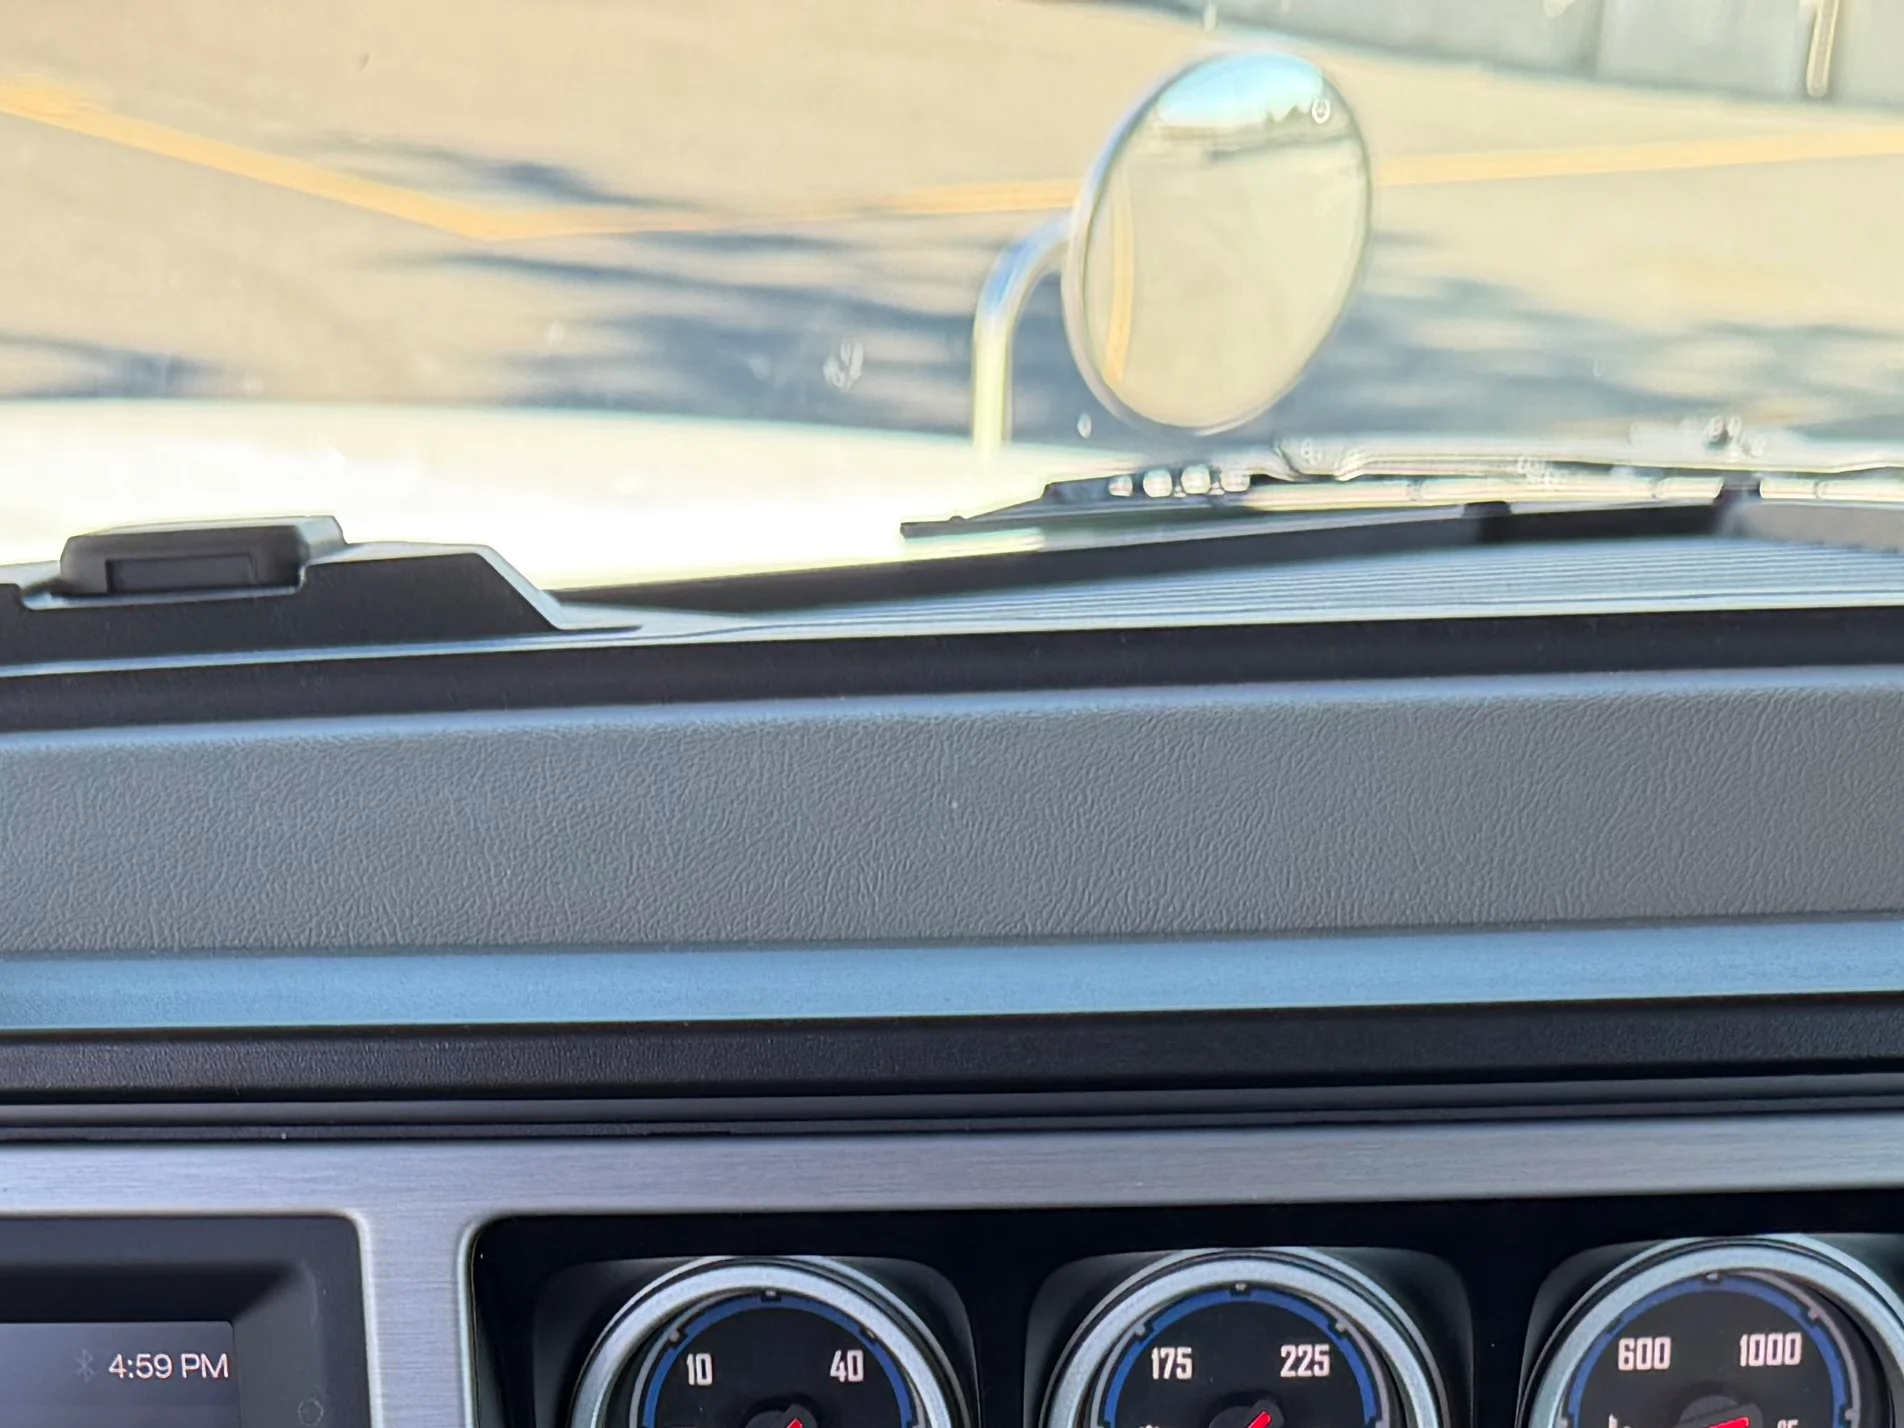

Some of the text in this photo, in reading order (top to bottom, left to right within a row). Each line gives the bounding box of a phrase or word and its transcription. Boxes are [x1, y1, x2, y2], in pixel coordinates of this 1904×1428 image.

[108, 1352, 230, 1380] 4:59 PM
[830, 1350, 864, 1383] 40
[1151, 1347, 1193, 1381] 175
[1280, 1344, 1331, 1378] 225
[1618, 1336, 1672, 1371] 600
[1739, 1332, 1803, 1367] 1000
[686, 1353, 714, 1386] 10
